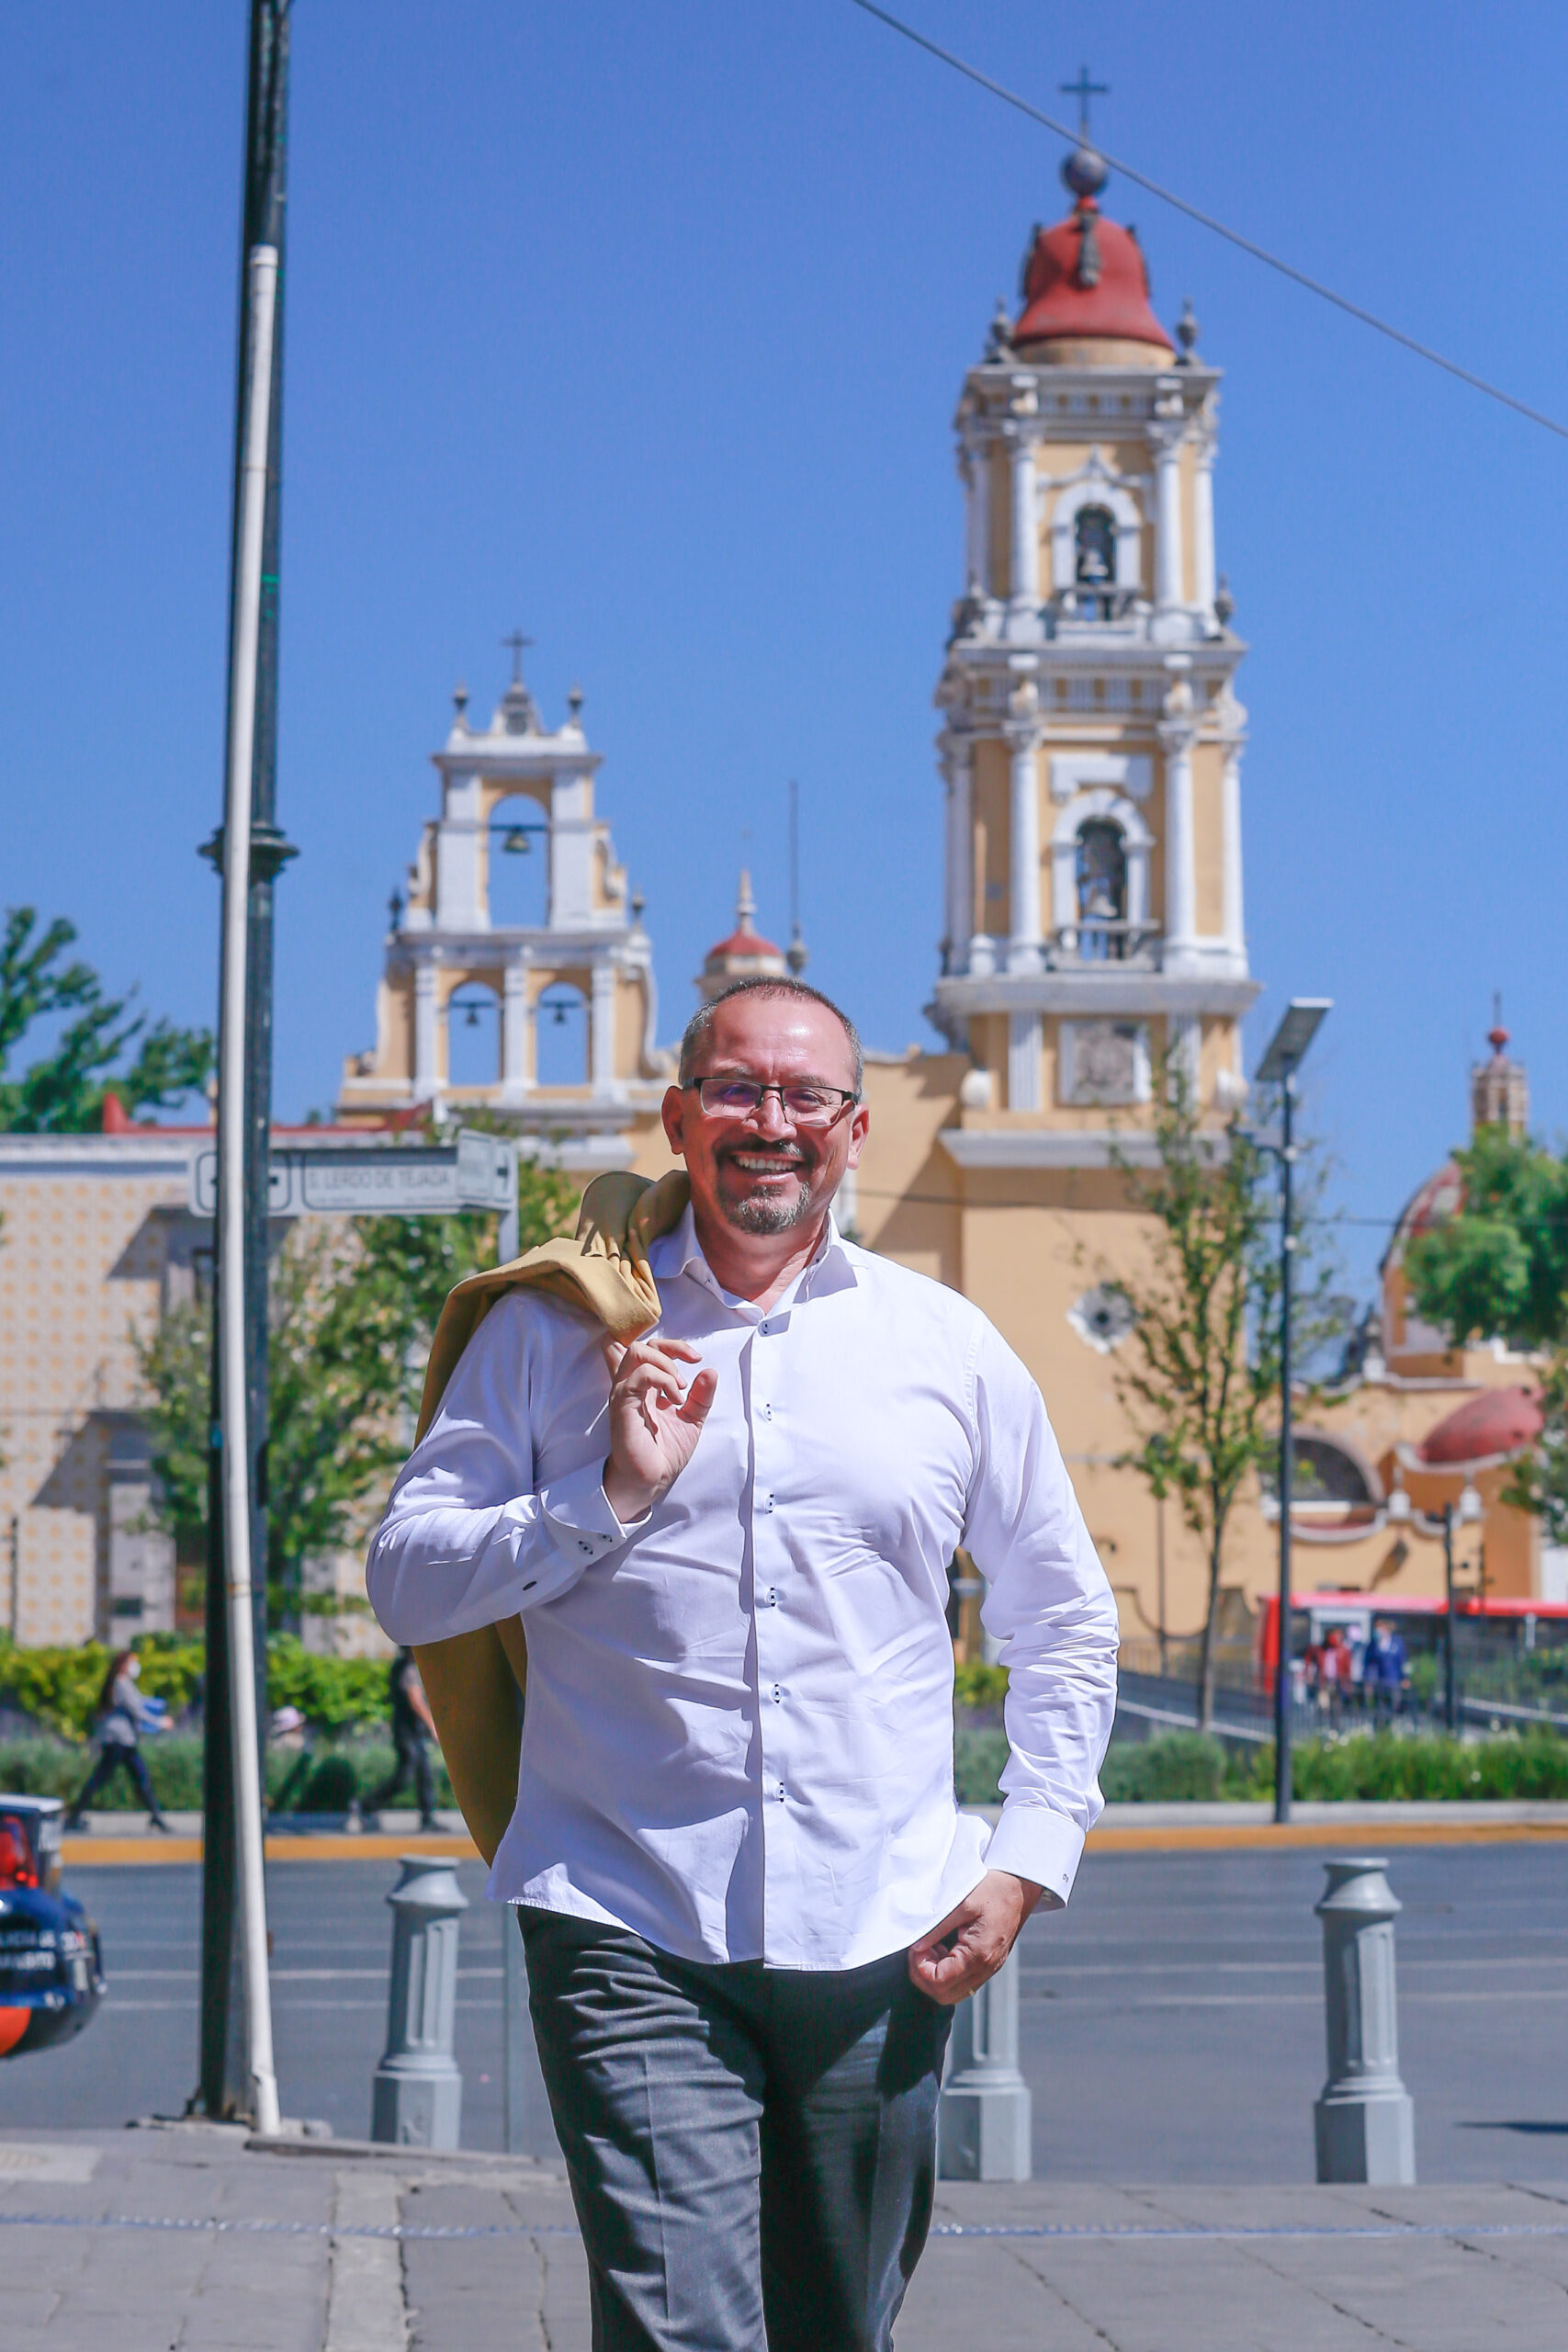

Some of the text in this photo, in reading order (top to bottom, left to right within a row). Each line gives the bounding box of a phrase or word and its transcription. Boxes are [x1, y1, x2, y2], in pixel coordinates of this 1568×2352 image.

[323, 1170, 372, 1190] LERDO
[375, 1170, 395, 1189] DE
[398, 1170, 450, 1188] TEJADA
